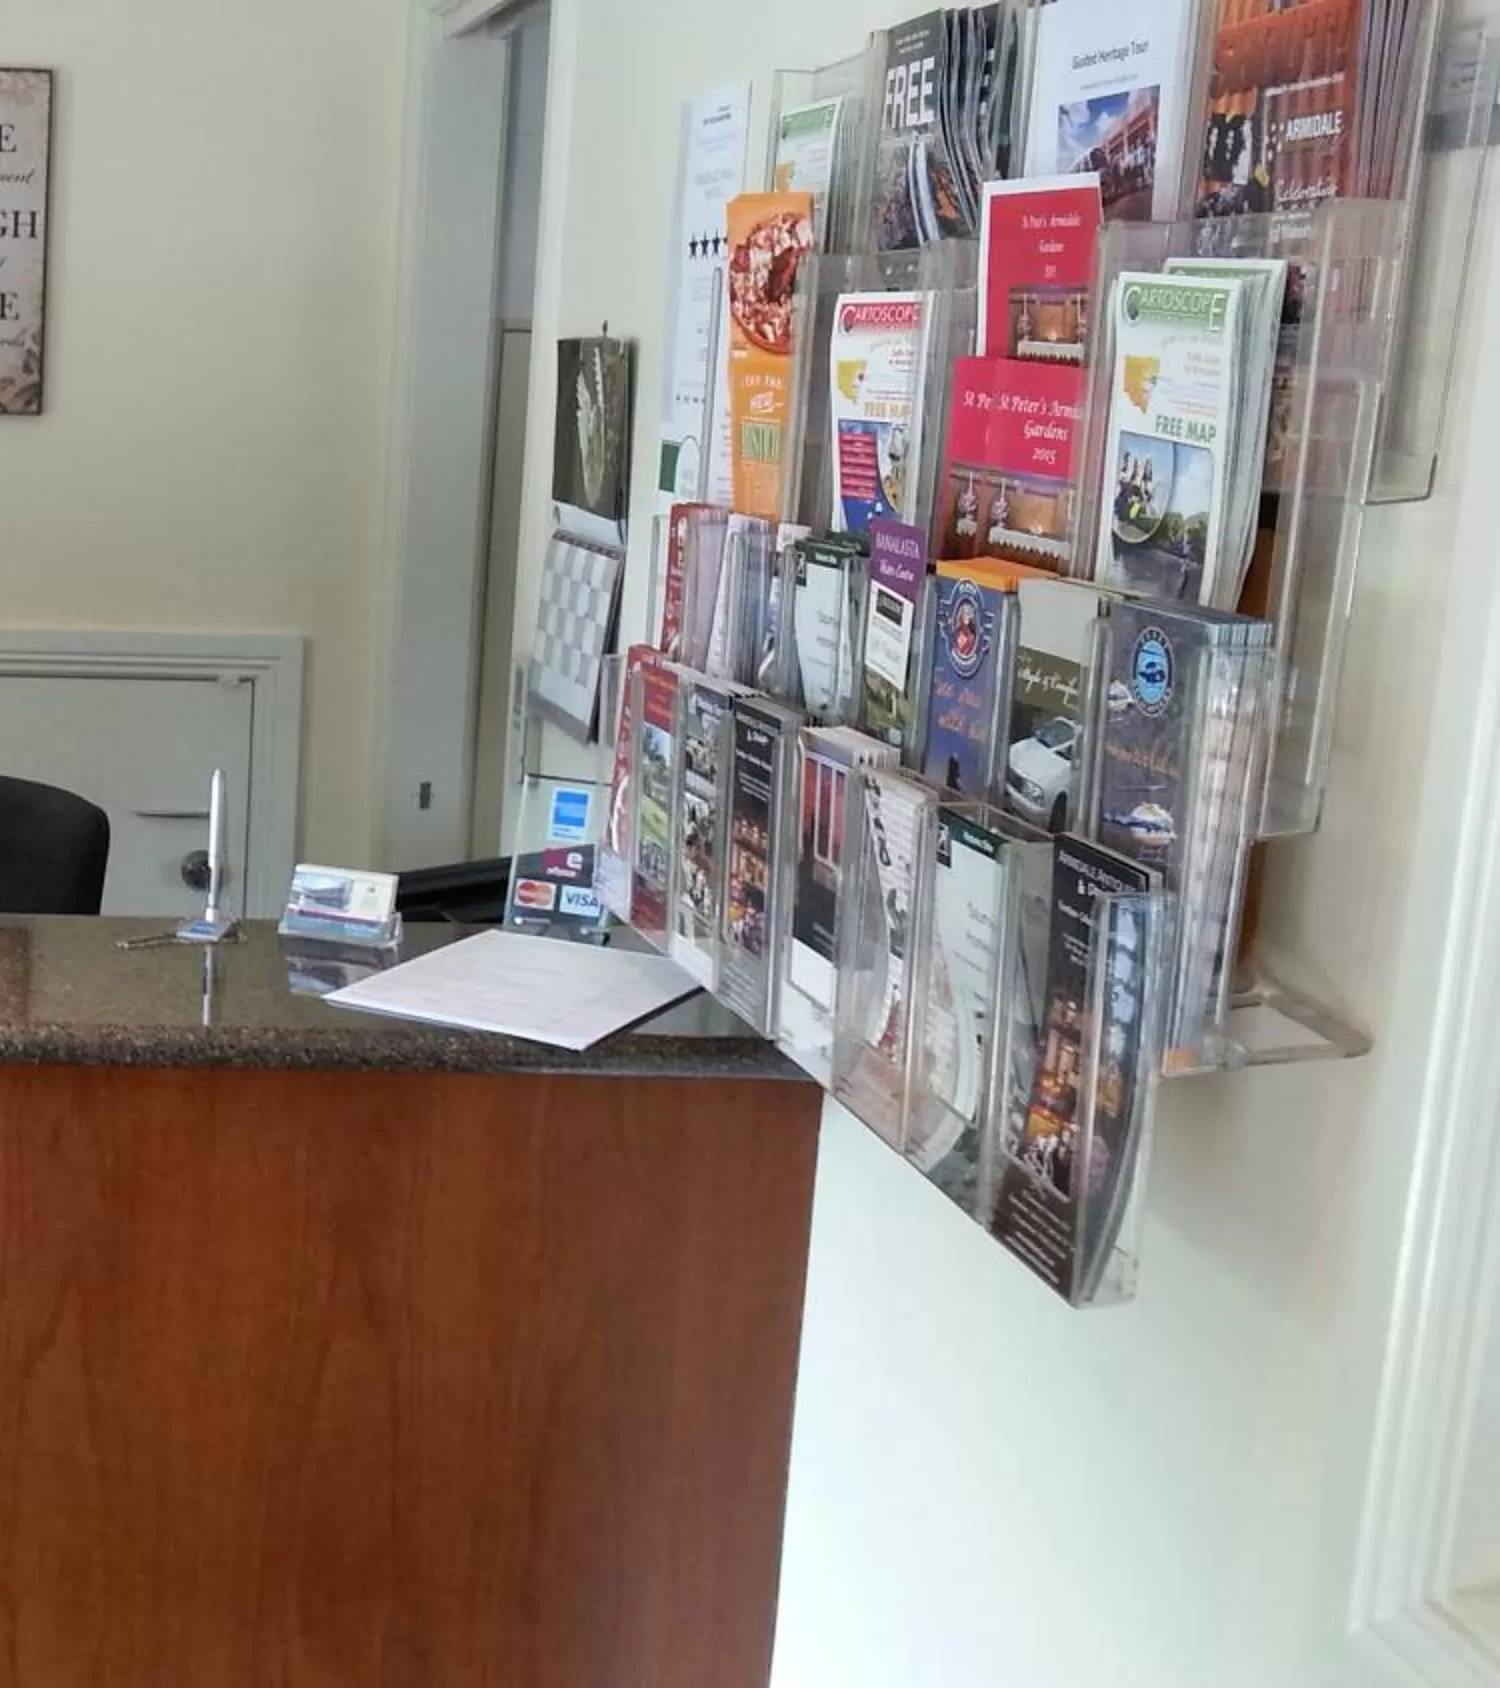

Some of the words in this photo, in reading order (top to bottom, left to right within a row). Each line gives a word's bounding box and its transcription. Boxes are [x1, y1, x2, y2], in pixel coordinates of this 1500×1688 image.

[1130, 40, 1150, 55] Tour
[882, 55, 935, 130] FREE
[1285, 110, 1344, 142] ARMIDALE
[1126, 284, 1227, 332] CARTOSCOPE
[1023, 419, 1069, 442] Gardens
[1155, 415, 1184, 438] FREE
[1185, 420, 1217, 443] MAP
[566, 893, 599, 908] VISA
